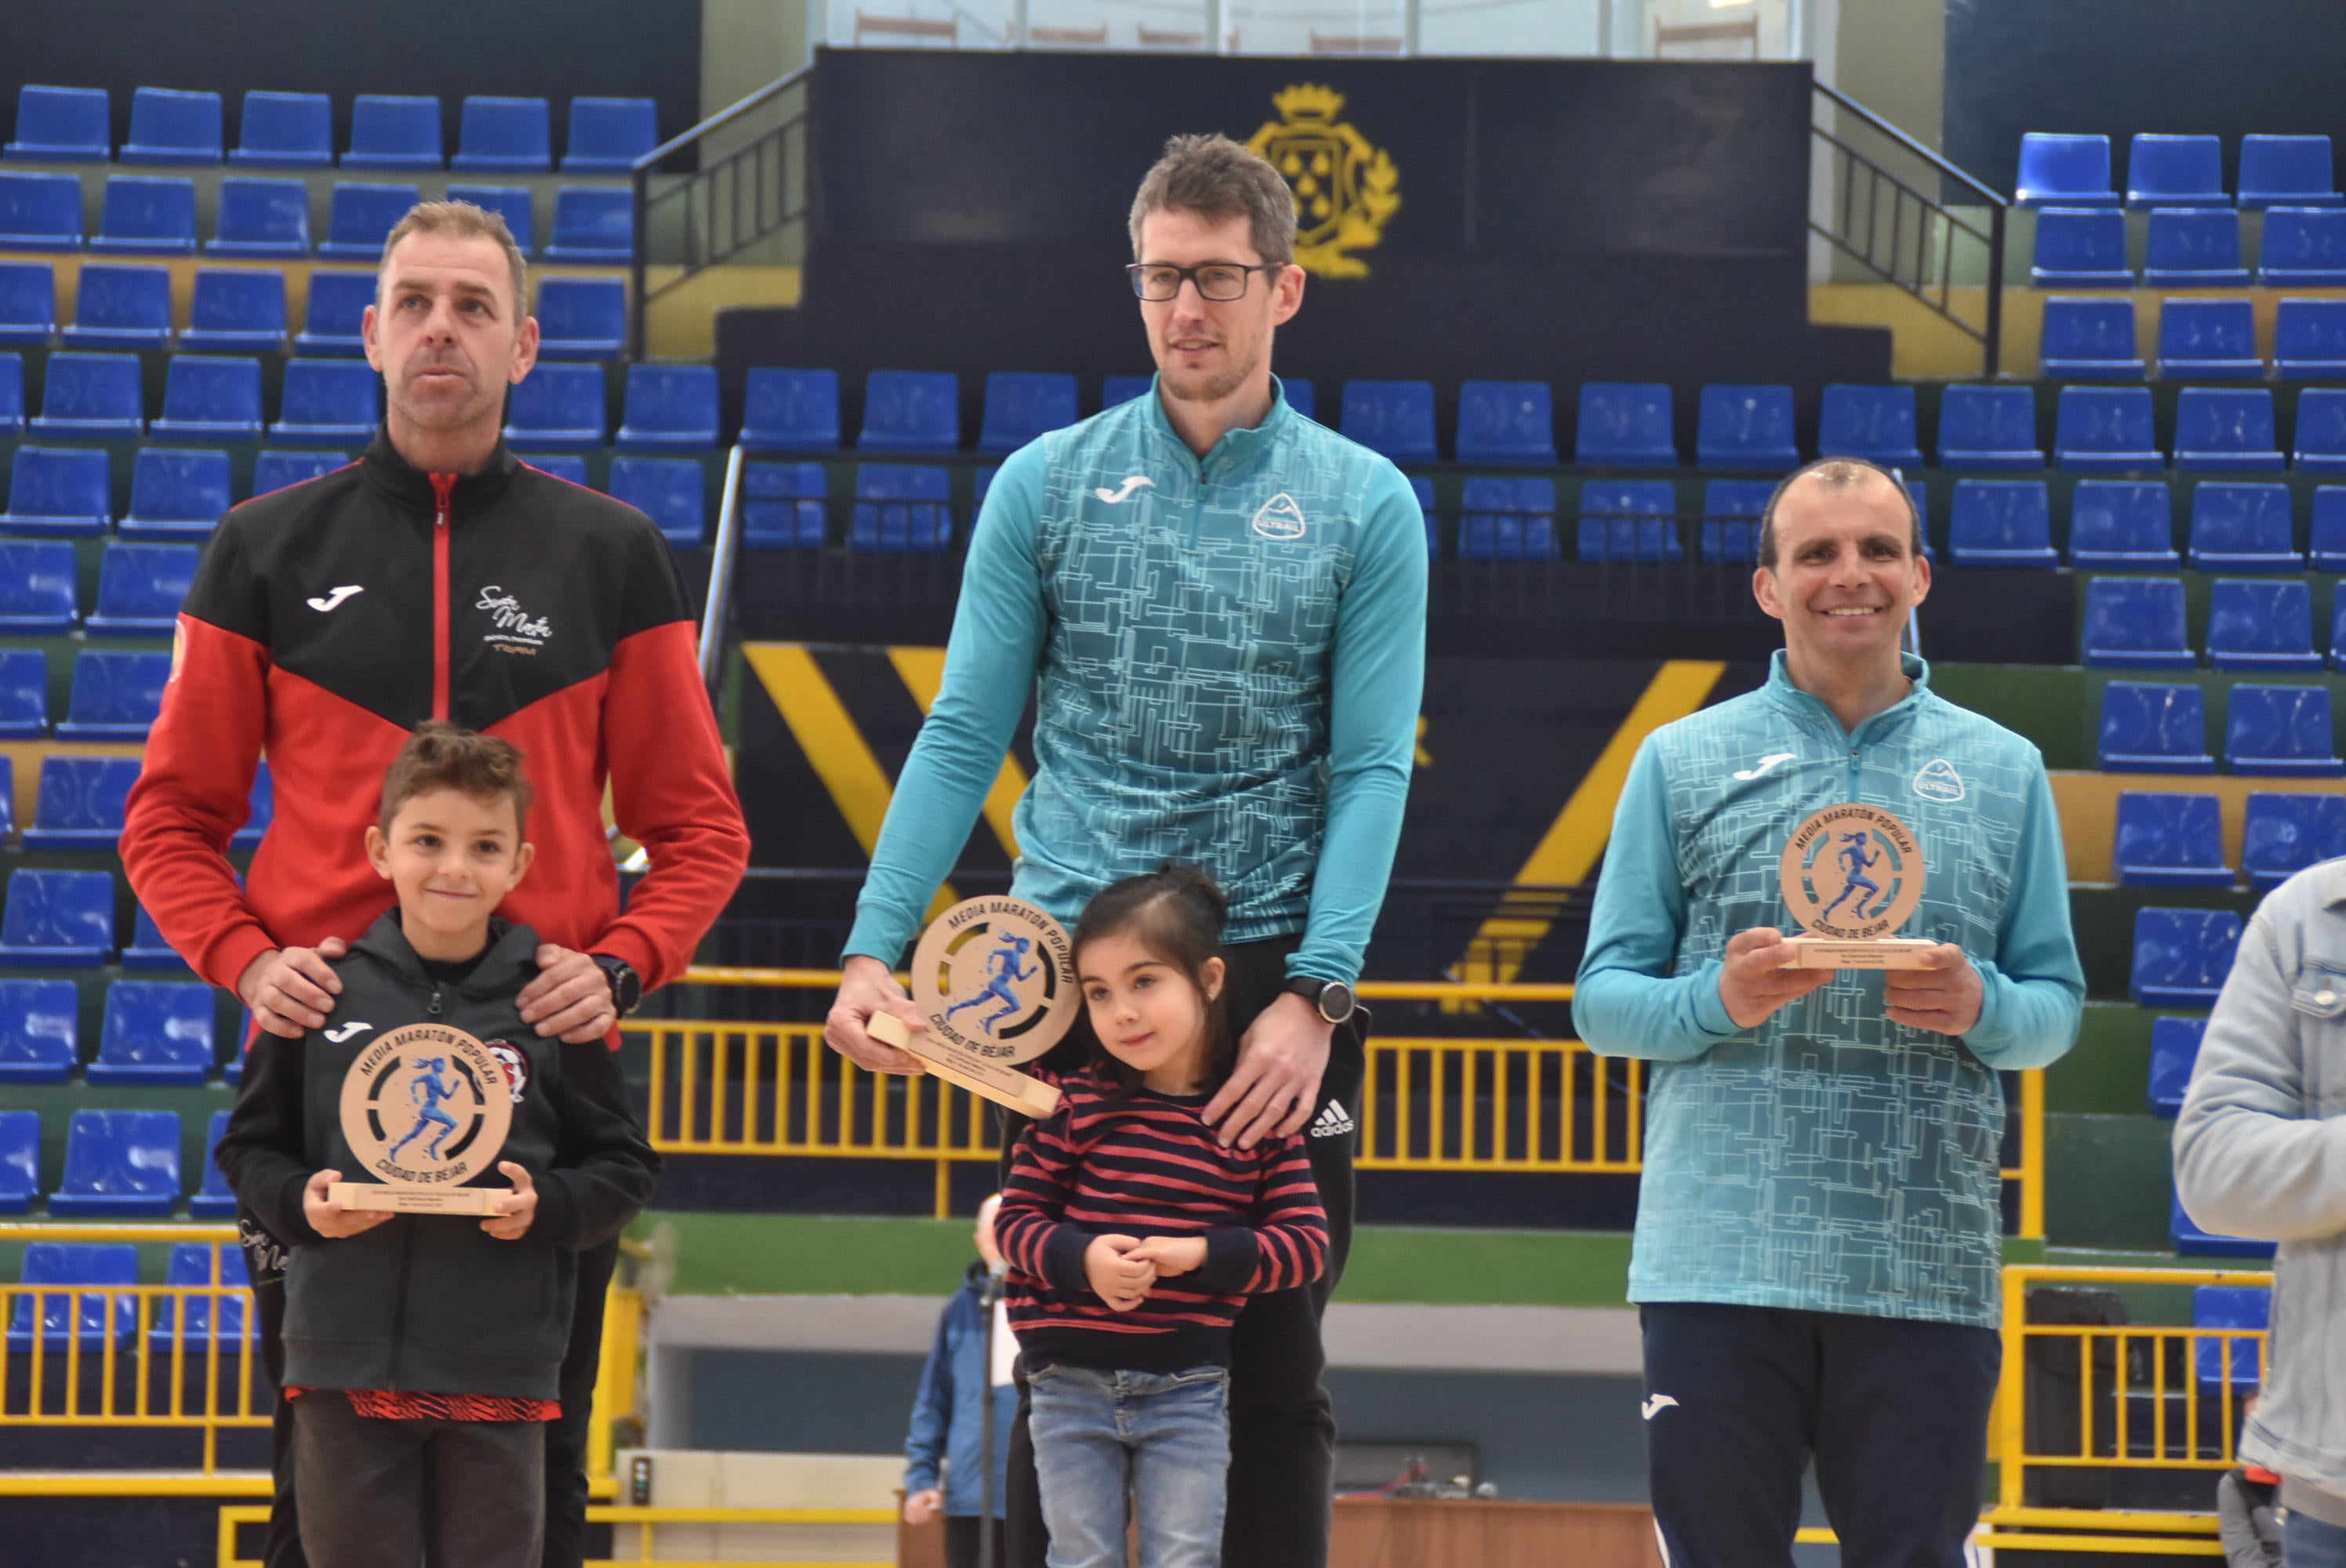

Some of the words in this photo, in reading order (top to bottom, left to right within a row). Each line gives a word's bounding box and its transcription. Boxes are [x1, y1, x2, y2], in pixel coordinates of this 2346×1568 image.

[1795, 819, 1822, 850] MEDIA
[1823, 808, 1876, 823] MARATÓN
[1876, 815, 1913, 853] POPULAR
[948, 903, 987, 930] MEDIA
[990, 902, 1050, 931] MARATÓN
[1047, 929, 1074, 984] POPULAR
[1811, 919, 1846, 938] CIUDAD
[1847, 928, 1860, 938] DE
[930, 1013, 965, 1045] CIUDAD
[964, 1040, 982, 1053] DE
[360, 1040, 394, 1076] MEDIA
[394, 1029, 456, 1047] MARATÓN
[455, 1039, 498, 1084] POPULAR
[1310, 1120, 1353, 1138] adidas
[375, 1159, 416, 1181] CIUDAD
[417, 1171, 433, 1183] DE
